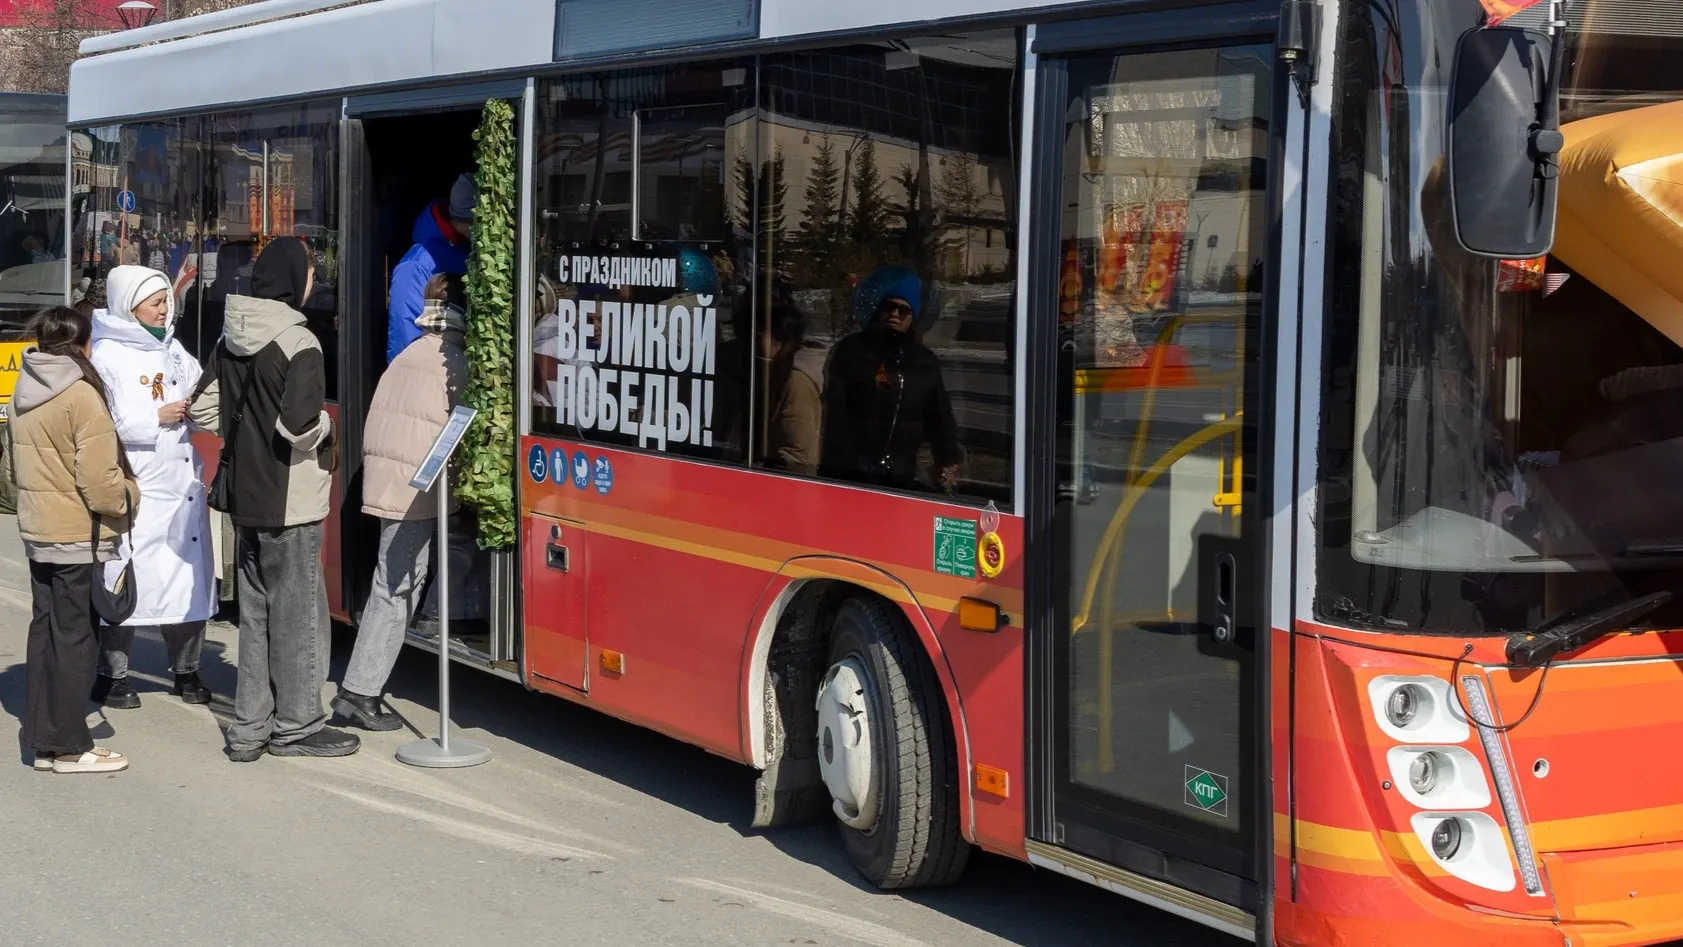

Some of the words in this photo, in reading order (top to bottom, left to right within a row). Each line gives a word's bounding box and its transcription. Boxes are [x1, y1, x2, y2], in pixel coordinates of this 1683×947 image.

[559, 255, 569, 283] С
[572, 255, 677, 289] ПРАЗДНИКОМ
[557, 294, 717, 375] ВЕЛИКОЙ
[556, 364, 714, 451] ПОБЕДЫ!
[1195, 781, 1218, 799] КПГ
